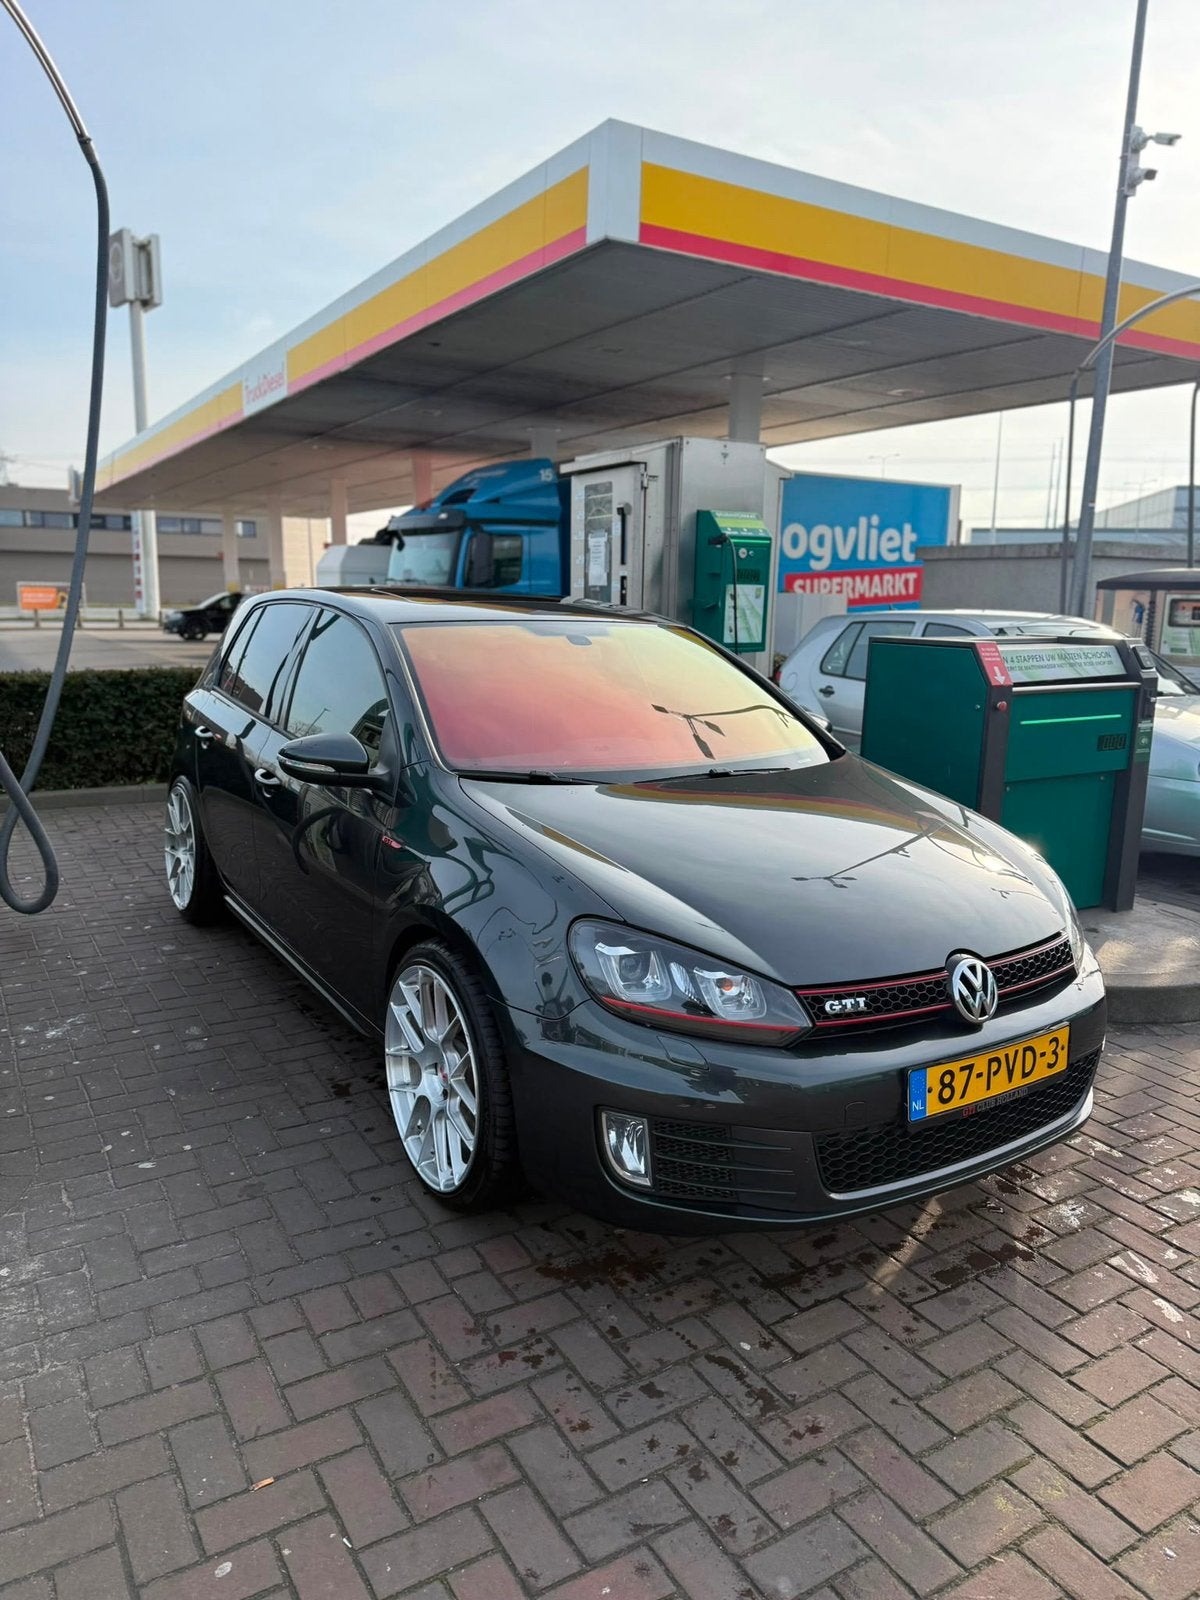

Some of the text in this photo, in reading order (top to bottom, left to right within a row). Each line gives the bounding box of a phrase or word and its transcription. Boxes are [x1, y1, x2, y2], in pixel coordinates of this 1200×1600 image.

[539, 468, 553, 481] 15
[793, 572, 918, 599] SUPERMARKT
[1015, 653, 1045, 664] STAPPEN
[1045, 653, 1056, 662] UW
[1057, 651, 1083, 661] MATTEN
[1083, 651, 1112, 659] SCHOON
[824, 997, 868, 1015] GTI
[937, 1036, 1060, 1105] 87-PVD-3
[912, 1100, 925, 1112] NL
[962, 1087, 1029, 1118] GTI CLUB HOLLAND
